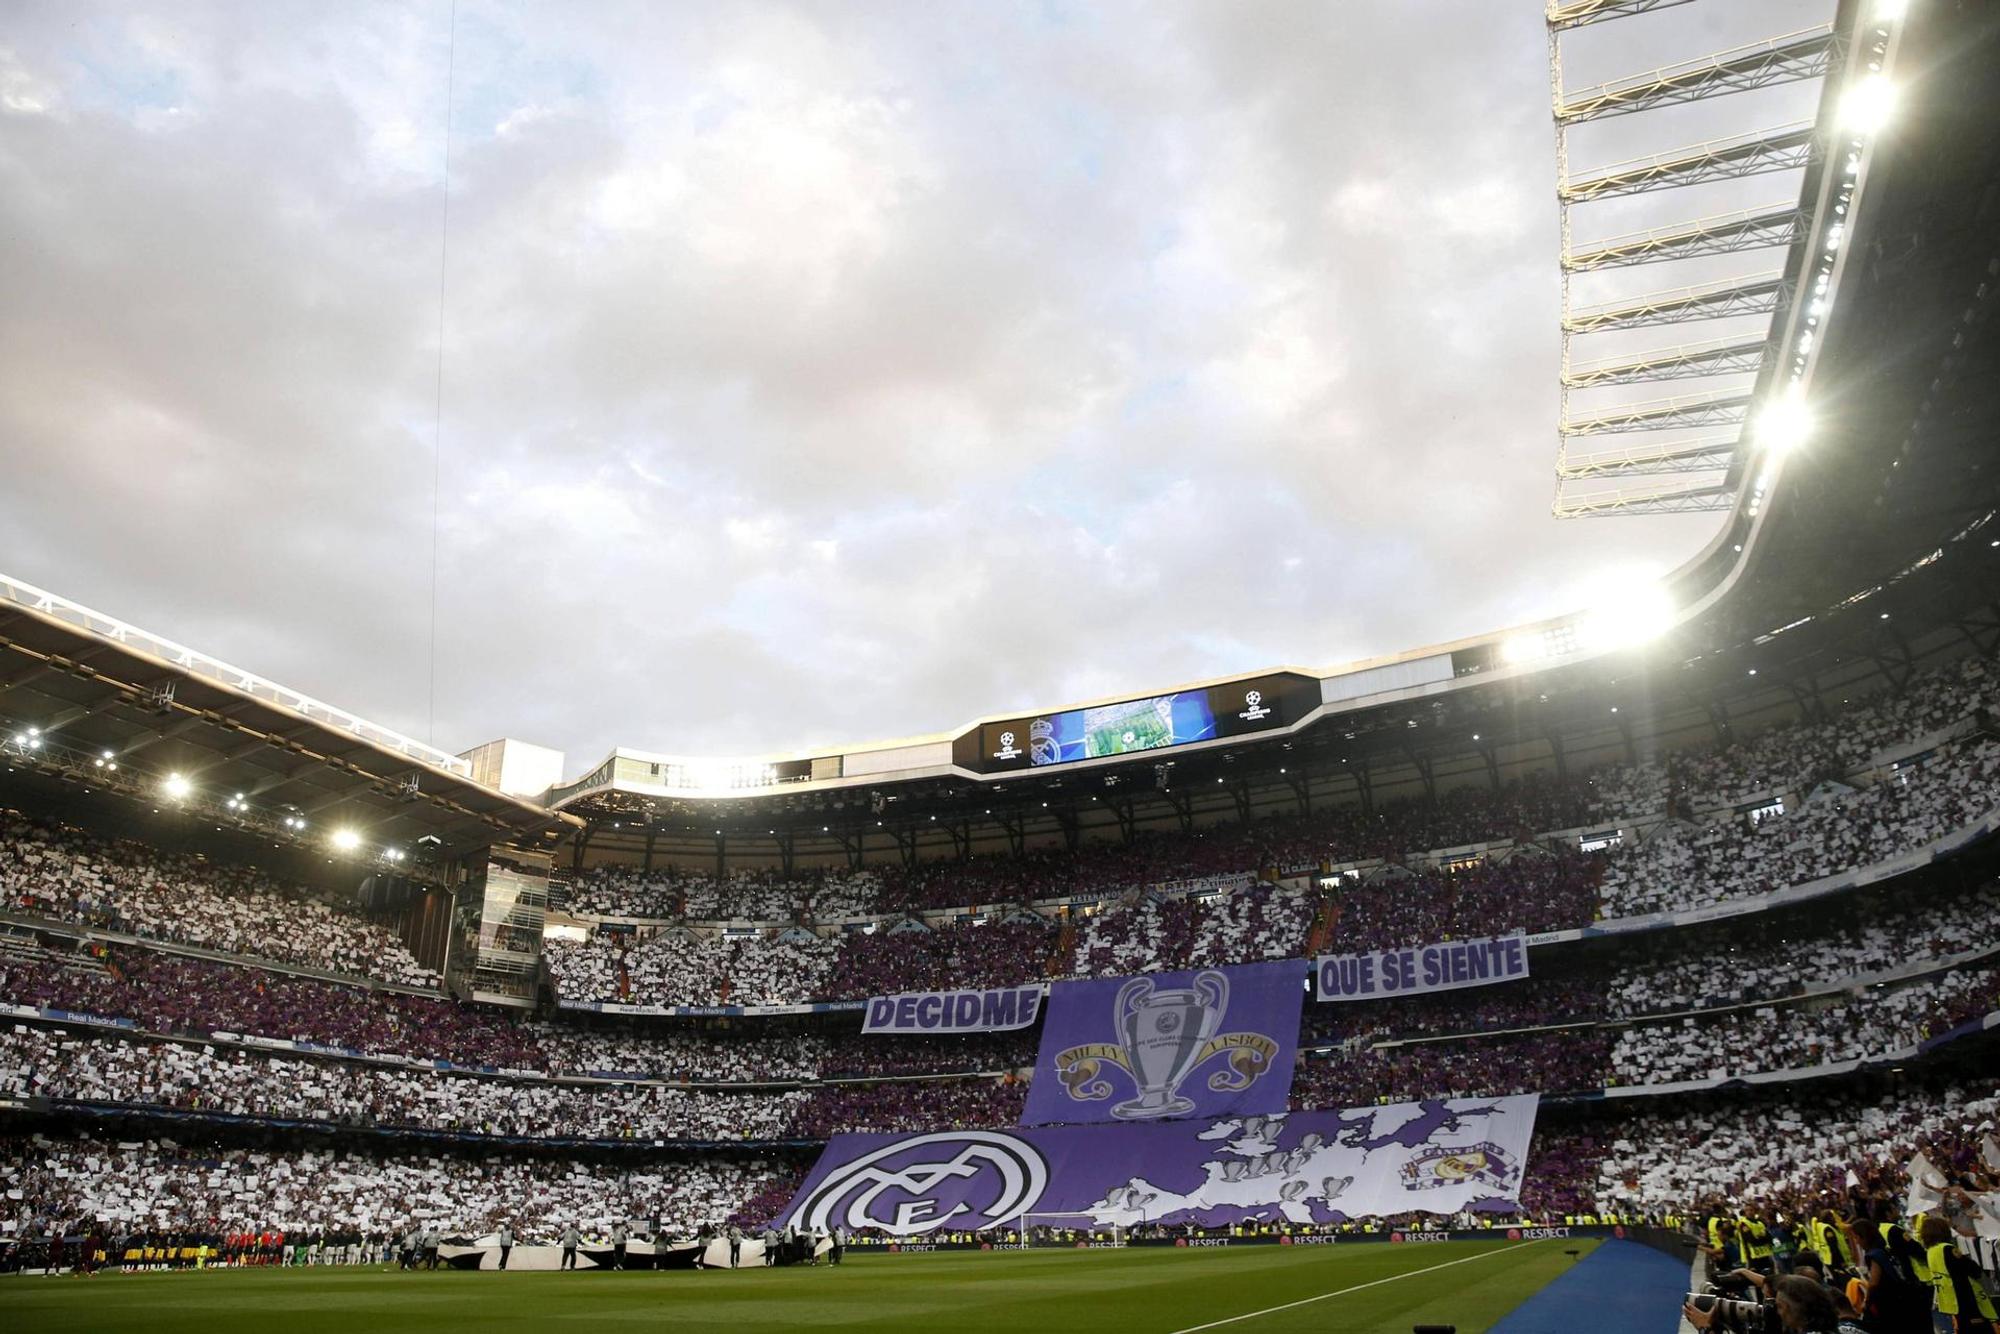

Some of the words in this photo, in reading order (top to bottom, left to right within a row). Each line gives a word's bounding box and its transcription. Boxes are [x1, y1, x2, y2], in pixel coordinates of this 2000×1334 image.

[1532, 935, 1559, 944] Madrid
[1320, 958, 1375, 997] QUE
[1381, 951, 1417, 991] SE
[1422, 938, 1523, 986] SIENTE
[869, 990, 1038, 1029] DECIDME
[67, 1012, 87, 1022] Real
[88, 1015, 117, 1026] Madrid
[1405, 1231, 1449, 1243] RESPECT
[1523, 1227, 1570, 1240] RESPECT
[1189, 1238, 1229, 1247] RESPECT
[1294, 1235, 1336, 1245] RESPECT
